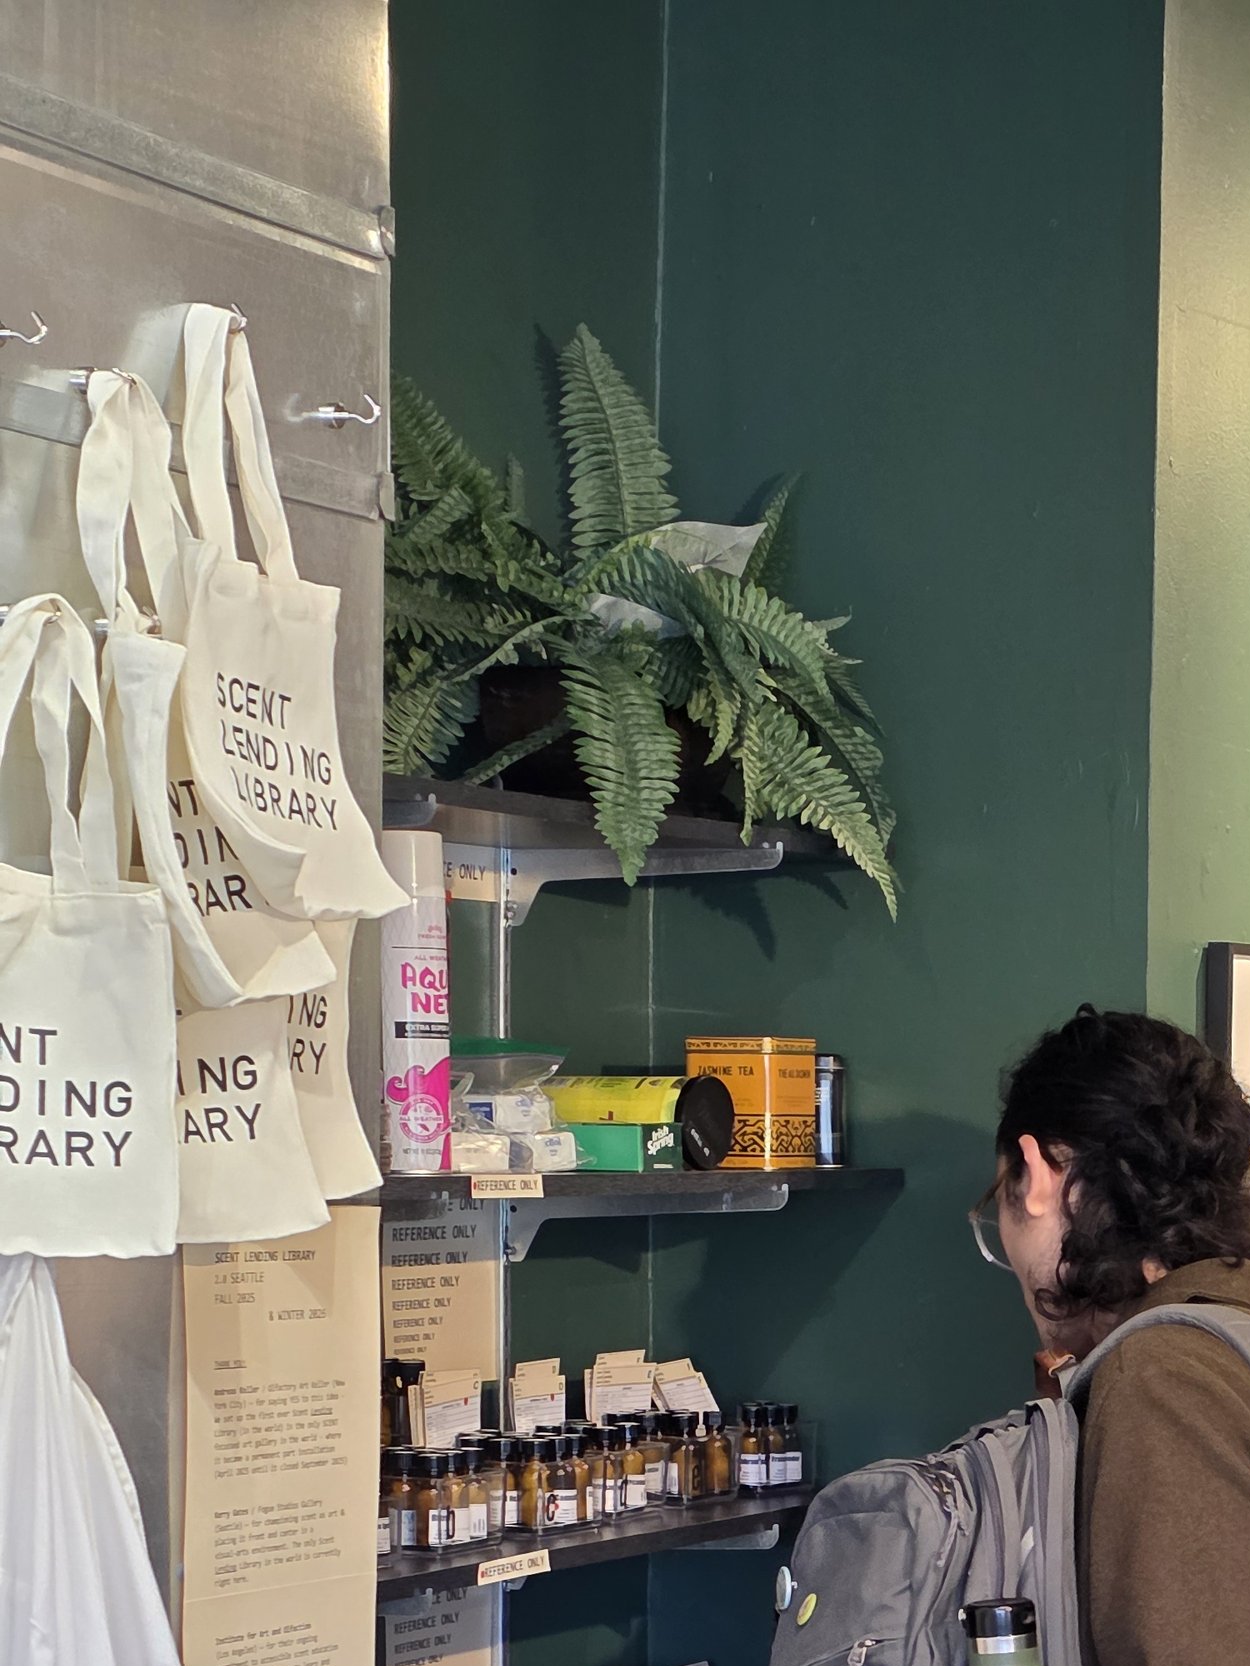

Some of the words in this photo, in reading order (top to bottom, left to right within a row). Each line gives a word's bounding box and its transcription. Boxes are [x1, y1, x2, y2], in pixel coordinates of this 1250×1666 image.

[216, 671, 292, 730] SCENT
[220, 718, 332, 786] LENDING
[230, 765, 338, 831] LIBRARY
[738, 1066, 754, 1076] TEA
[476, 1179, 517, 1191] REFERENCE
[519, 1179, 538, 1191] ONLY
[392, 1225, 447, 1242] REFERENCE
[452, 1224, 477, 1239] ONLY
[215, 1251, 239, 1263] SCENT
[244, 1250, 278, 1262] LENDING
[282, 1249, 315, 1261] LIBRARY
[391, 1252, 441, 1267] REFERENCE
[445, 1251, 468, 1265] ONLY
[230, 1271, 264, 1283] SEATTLE
[391, 1277, 436, 1291] REFERENCE
[440, 1275, 460, 1289] ONLY
[392, 1299, 431, 1311] REFERENCE
[434, 1297, 451, 1308] ONLY
[278, 1309, 304, 1320] WINTER
[484, 1560, 523, 1577] REFERENCE
[527, 1556, 544, 1568] ONLY
[394, 1616, 436, 1634] REFERENCE
[441, 1611, 461, 1625] ONLY
[394, 1637, 431, 1654] REFERENCE
[434, 1633, 451, 1646] ONLY
